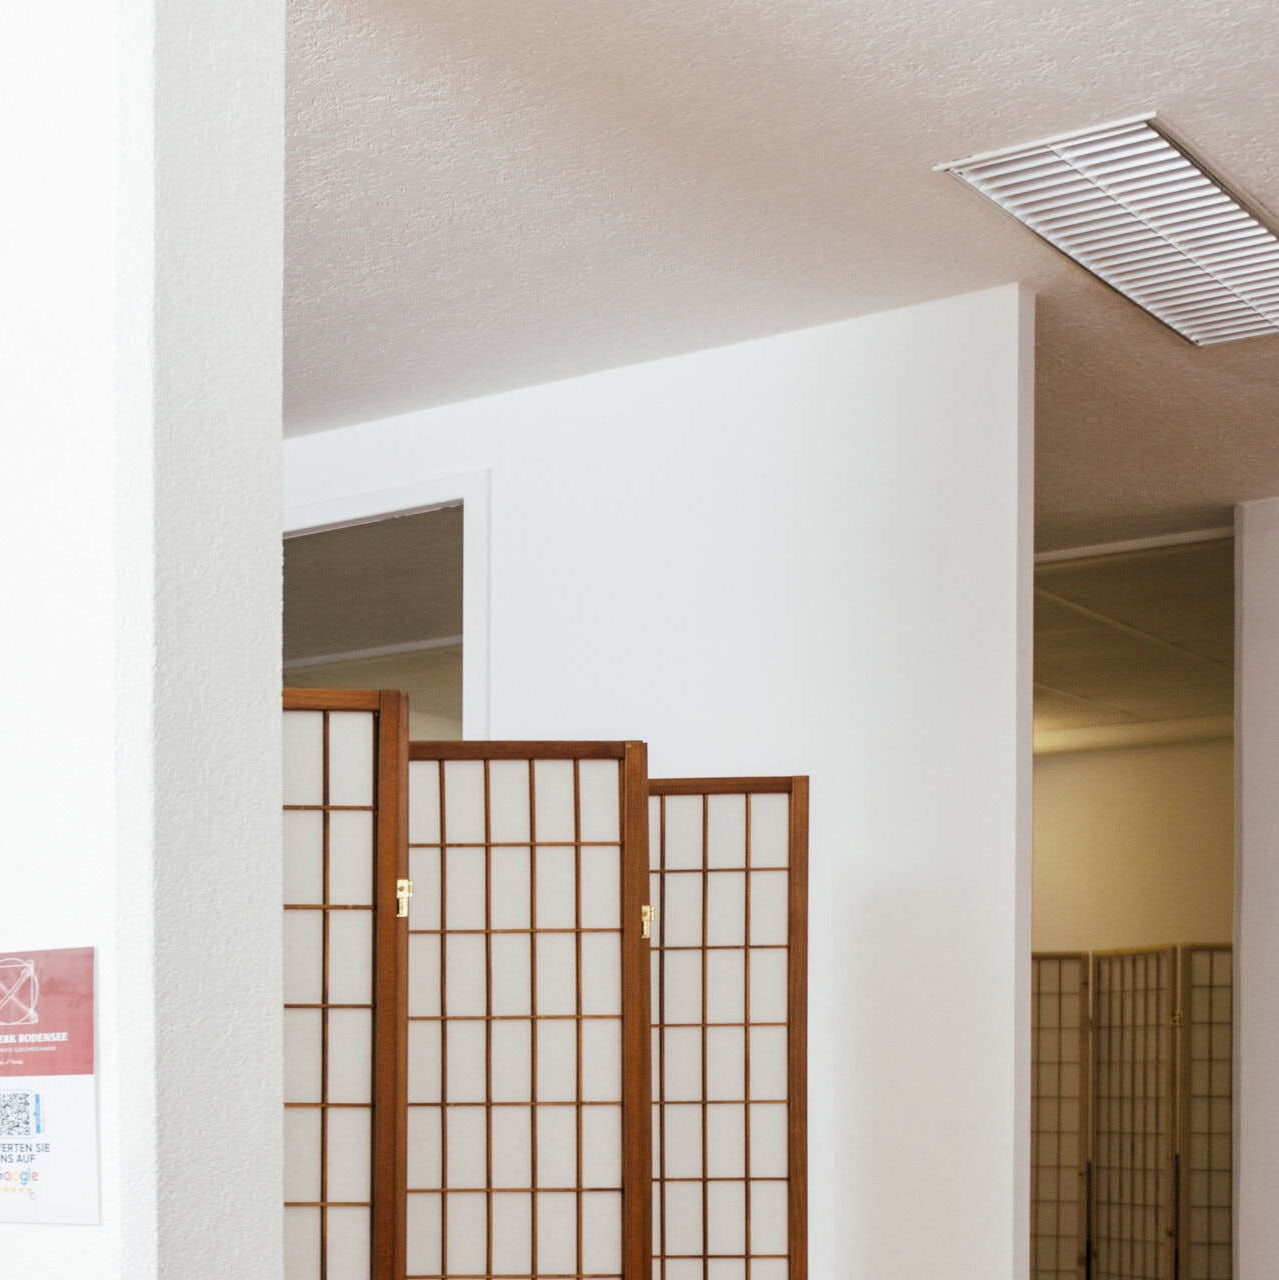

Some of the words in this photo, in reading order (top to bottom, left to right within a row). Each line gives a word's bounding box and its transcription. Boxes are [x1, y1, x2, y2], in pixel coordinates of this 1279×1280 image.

[18, 1032, 69, 1043] BODENSEE
[35, 1143, 50, 1153] SIE
[16, 1154, 36, 1163] AUF
